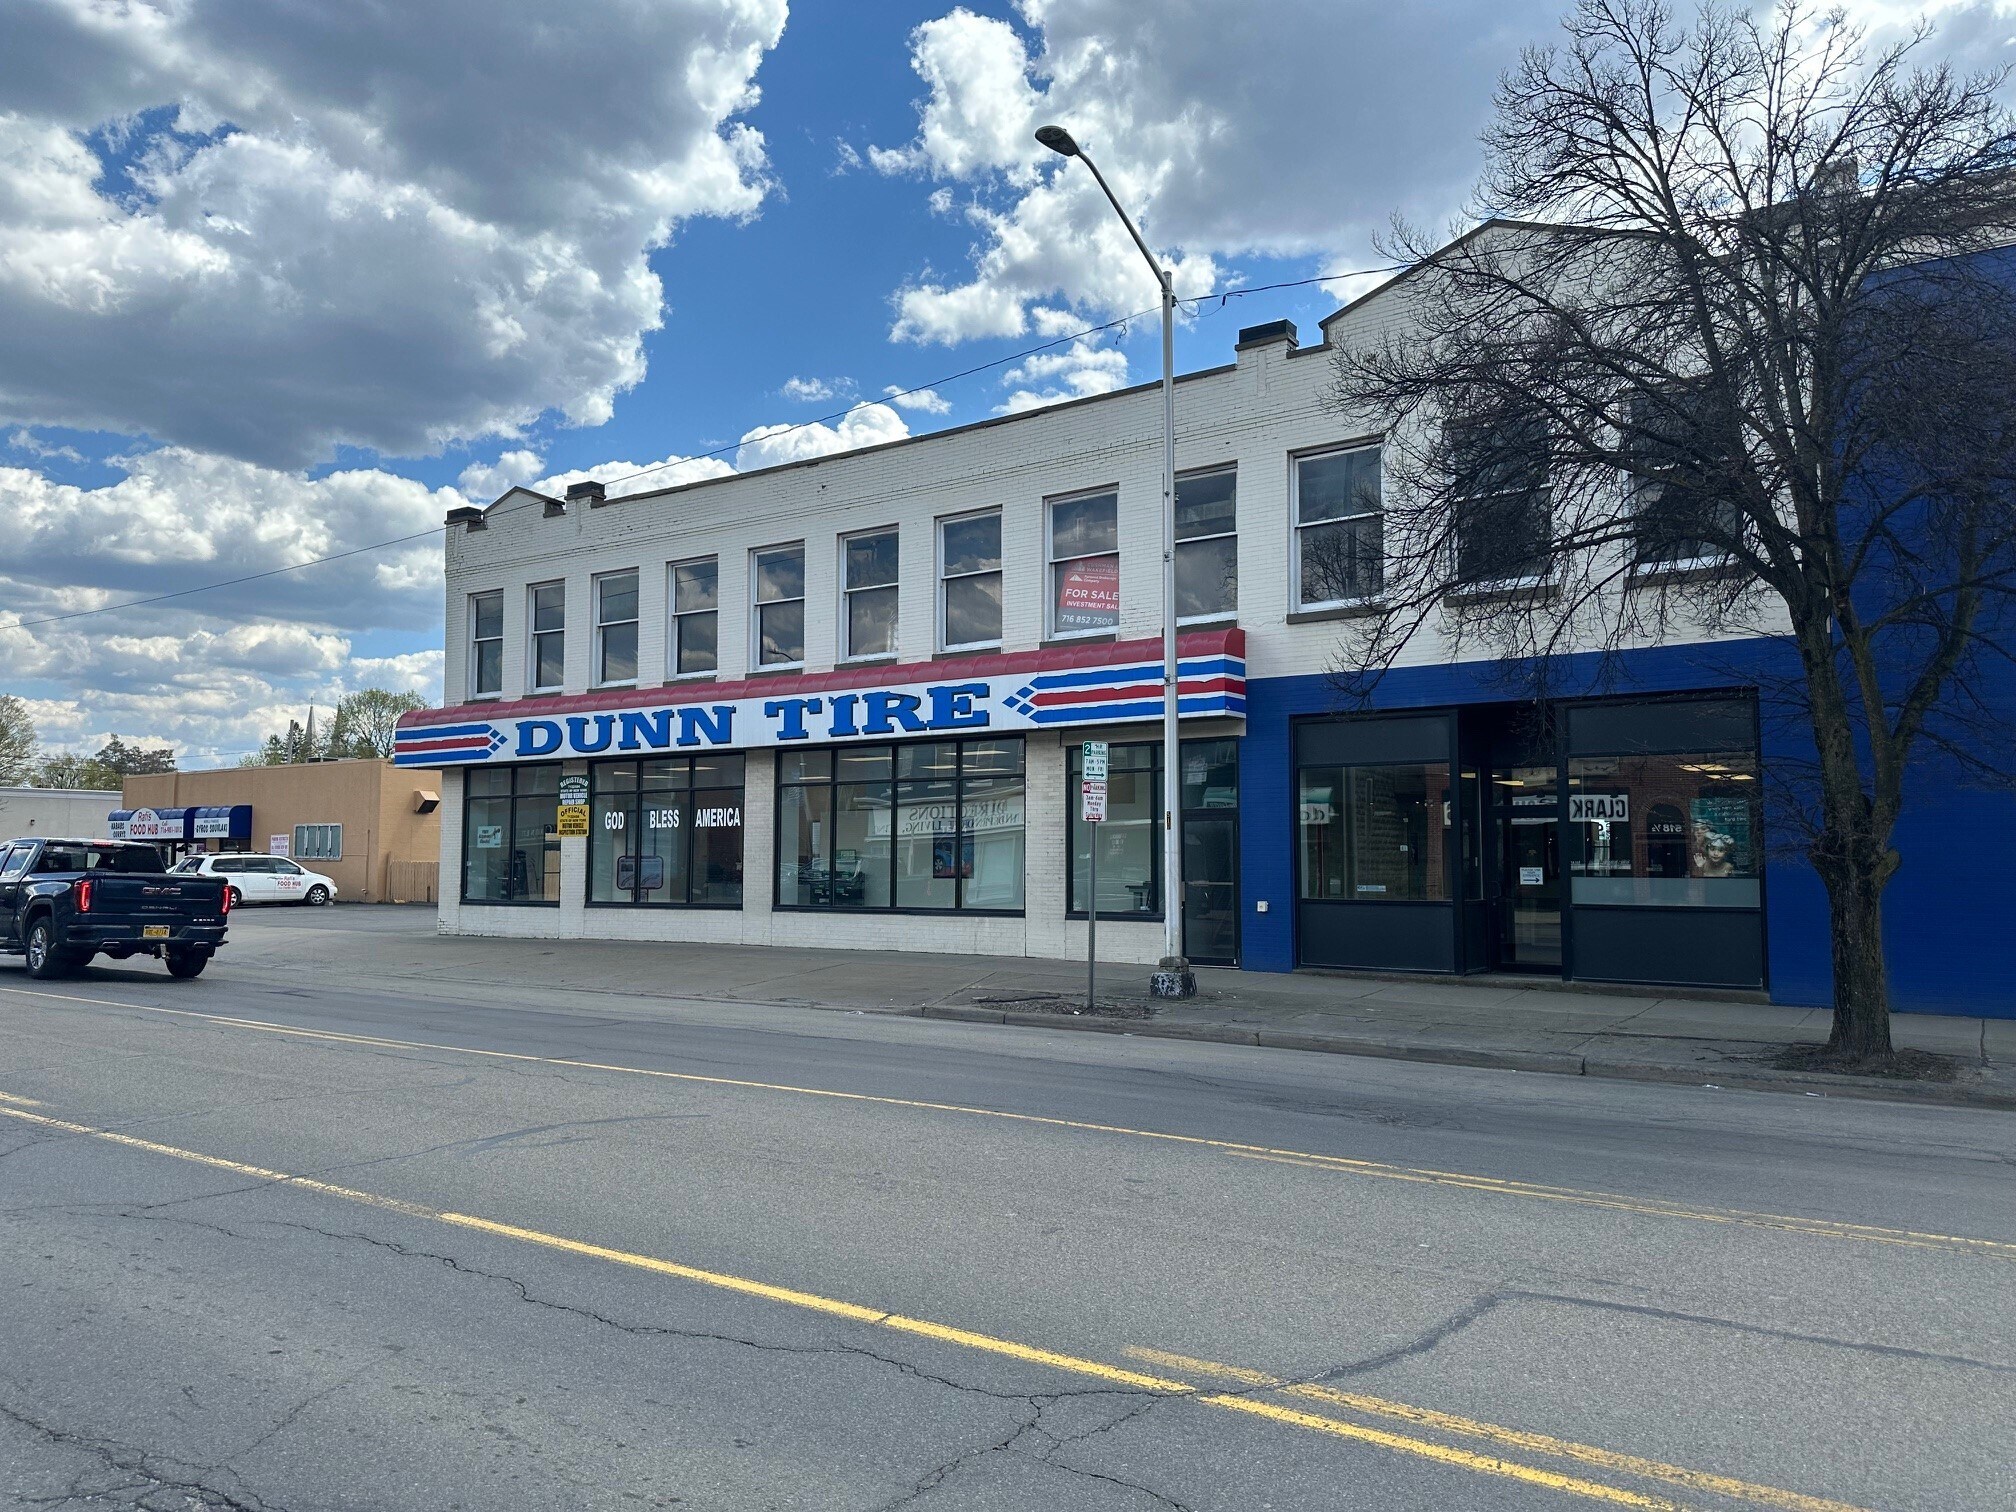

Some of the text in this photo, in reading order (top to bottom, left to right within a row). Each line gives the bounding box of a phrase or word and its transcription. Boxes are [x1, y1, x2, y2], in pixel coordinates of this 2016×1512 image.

[1065, 588, 1119, 600] FOR SALE
[1066, 600, 1105, 608] INVESTMENT
[1061, 614, 1113, 625] 716 852 7500
[515, 682, 990, 757] DUNN TIRE
[1084, 744, 1091, 755] 2
[560, 776, 589, 788] REGISTERED
[1083, 783, 1090, 791] NO
[560, 806, 587, 817] OFFICIAL
[605, 808, 741, 829] GOD BLESS AMERICA
[111, 822, 125, 830] KABABS
[130, 823, 159, 836] FOOD HUB
[196, 823, 228, 834] GYROS SOUVLAKI
[143, 887, 181, 895] GMC
